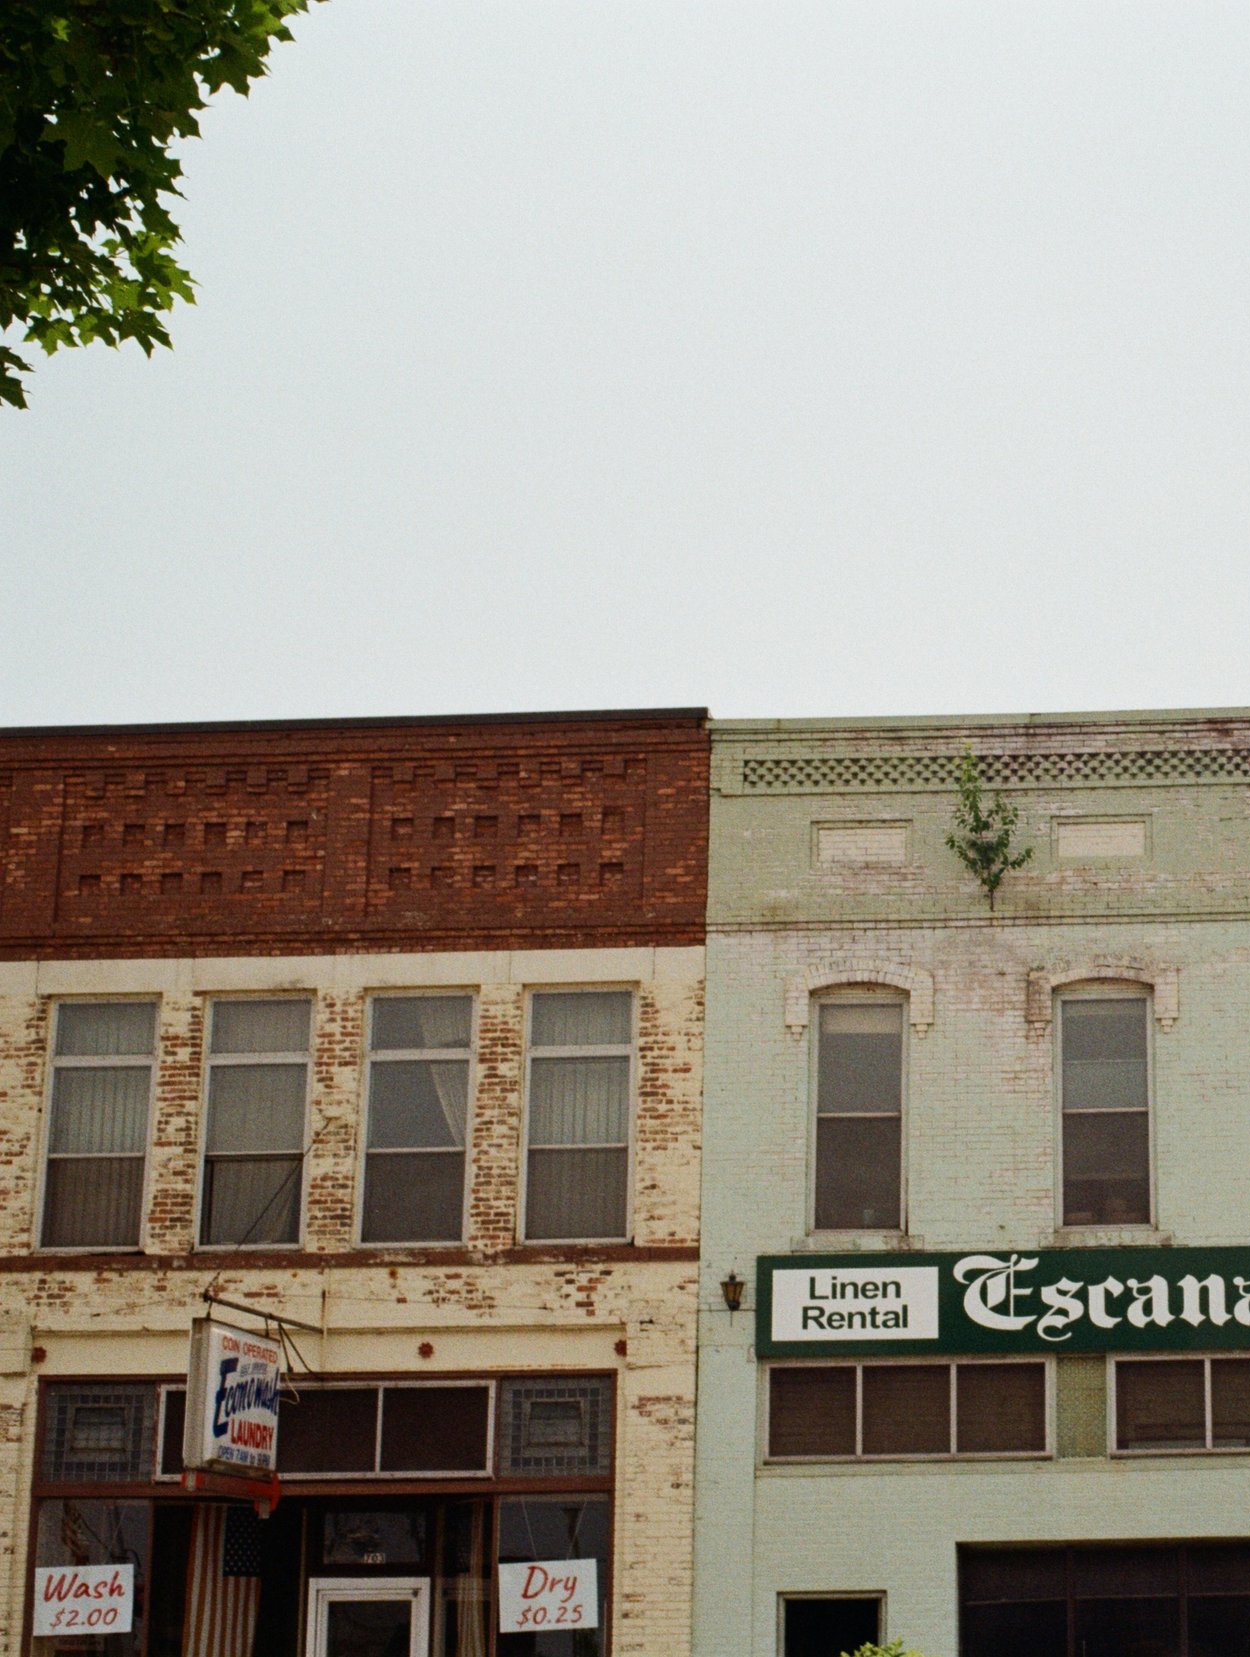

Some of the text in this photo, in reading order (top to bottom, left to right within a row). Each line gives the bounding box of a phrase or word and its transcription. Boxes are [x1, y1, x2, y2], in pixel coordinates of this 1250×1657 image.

[809, 1276, 901, 1300] Linen
[802, 1304, 908, 1330] Rental
[243, 1342, 278, 1364] OPERATED
[231, 1418, 275, 1451] LAUNDRY
[43, 1570, 126, 1603] Wash
[521, 1565, 578, 1603] Dry
[50, 1607, 118, 1630] $2.00
[515, 1604, 583, 1629] $0.25
